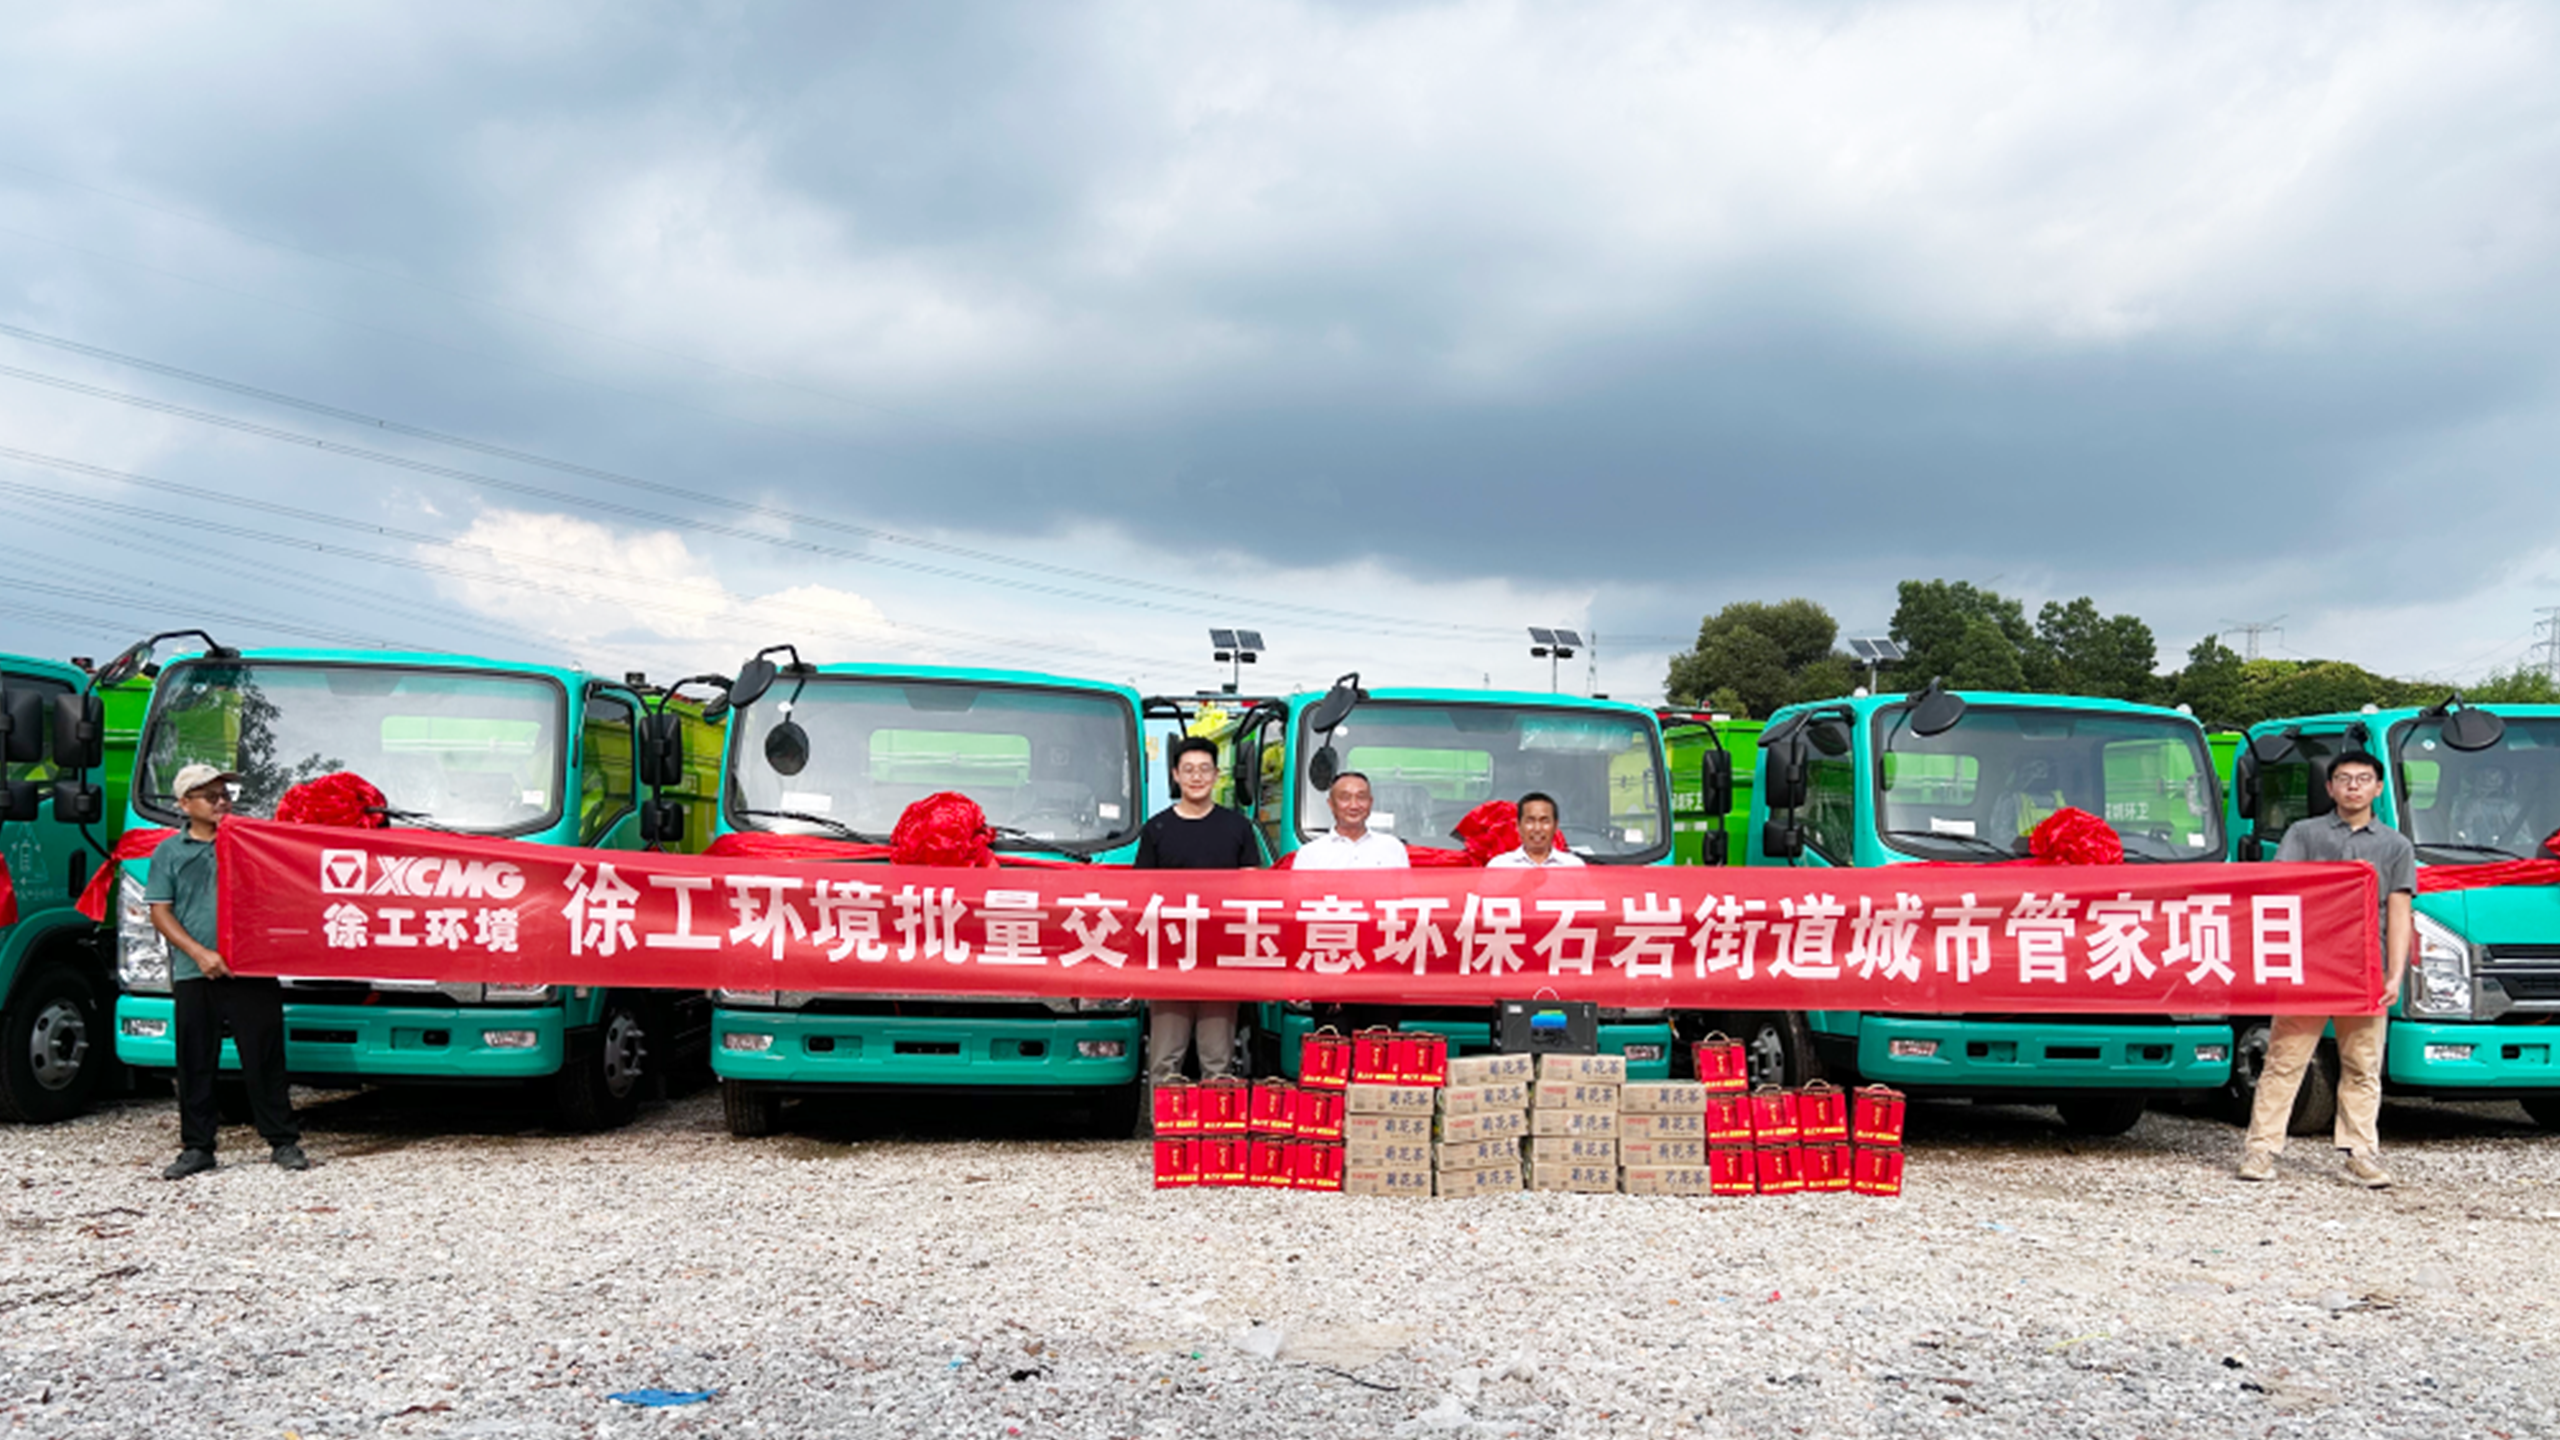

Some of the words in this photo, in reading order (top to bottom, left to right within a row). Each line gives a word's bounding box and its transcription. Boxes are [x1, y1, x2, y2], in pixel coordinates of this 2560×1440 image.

[366, 855, 526, 899] XCMG
[323, 902, 519, 952] 徐工环境
[561, 862, 2304, 986] 徐工环境批量交付玉意环保石岩街道城市管家项目
